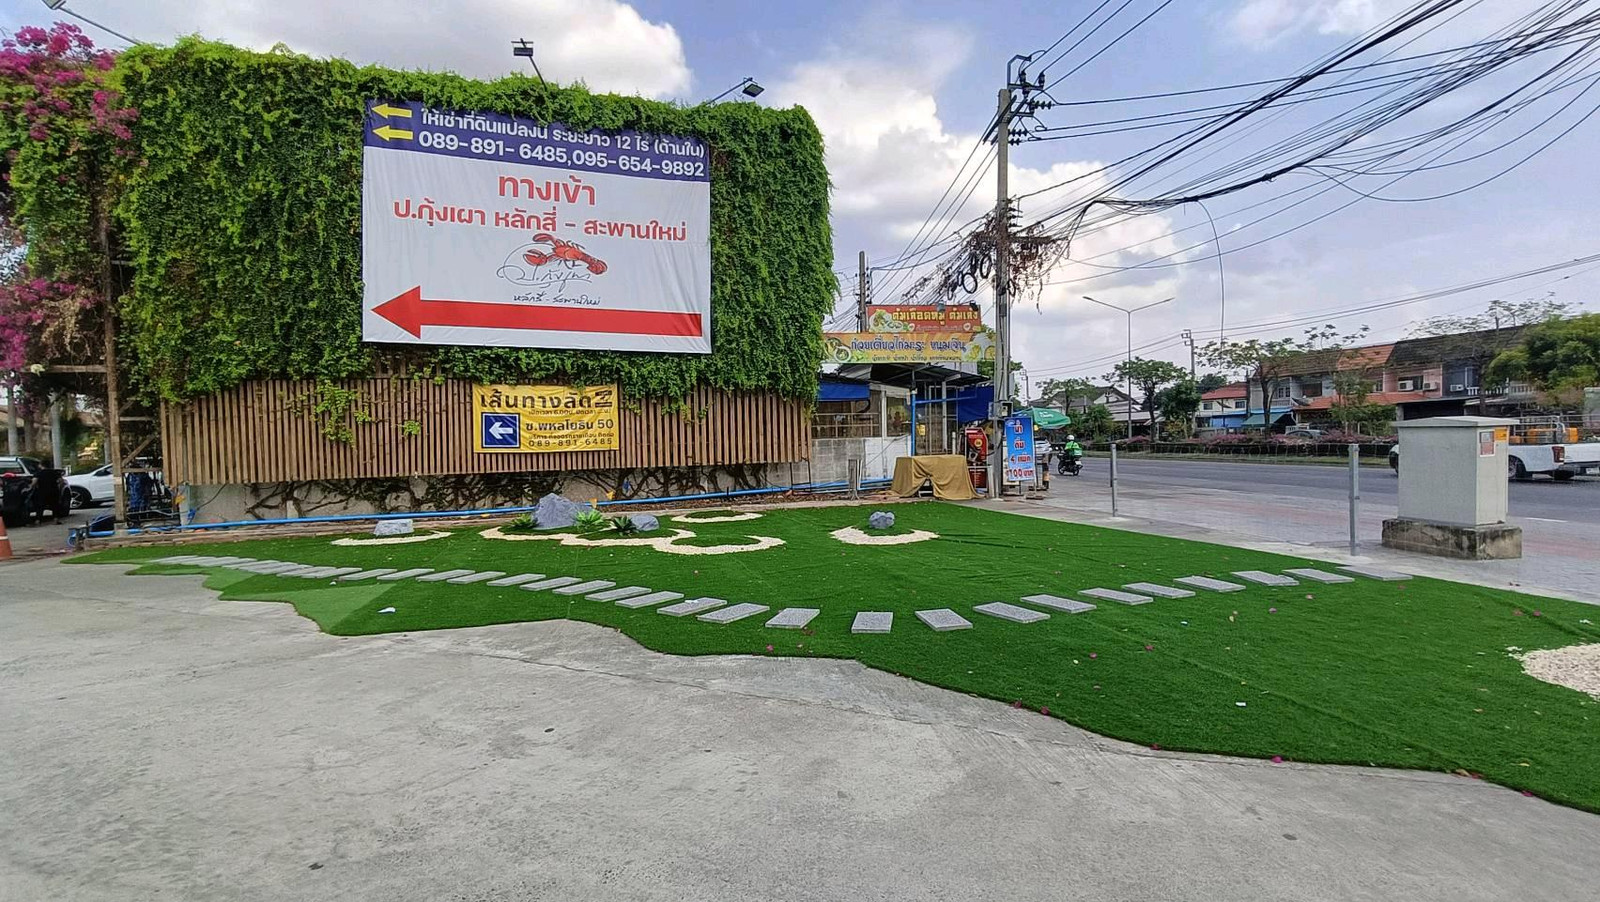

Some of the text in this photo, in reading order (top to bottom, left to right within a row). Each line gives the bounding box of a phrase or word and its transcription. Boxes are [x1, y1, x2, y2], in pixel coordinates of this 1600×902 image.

[552, 128, 611, 147] ระยะยาว
[615, 135, 631, 150] 12
[636, 135, 650, 152] ไร่
[654, 139, 705, 159] (ด้านใน)
[498, 174, 596, 206] ทางเข้า
[393, 198, 486, 227] ป.กุ้งเผา
[494, 206, 558, 232] หลักสี่
[583, 219, 687, 242] สะพานใหม่
[480, 388, 592, 409] เส้นทางลัด
[526, 418, 614, 432] ซ.พหลโยธิน 50
